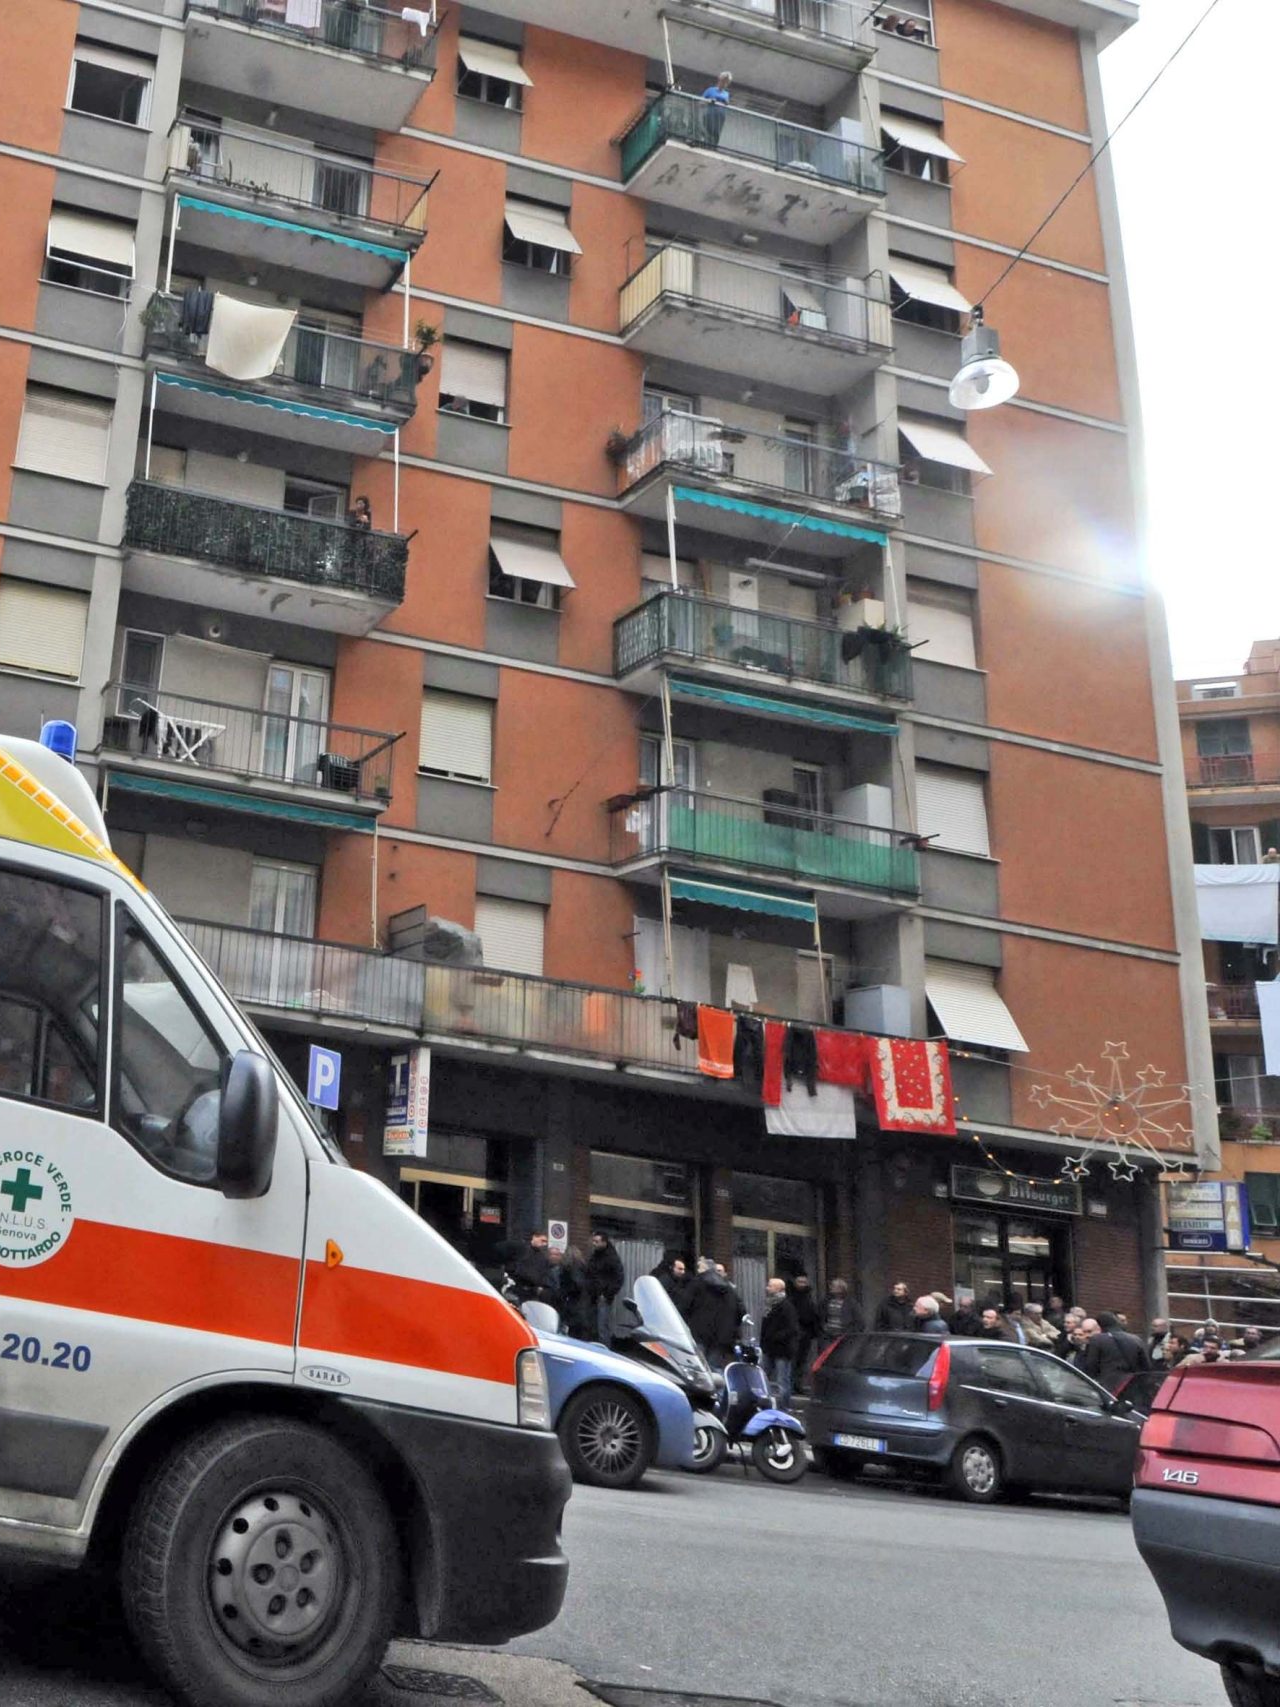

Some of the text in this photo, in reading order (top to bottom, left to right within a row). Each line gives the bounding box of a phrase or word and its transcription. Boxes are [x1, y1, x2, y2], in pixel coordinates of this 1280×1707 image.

[313, 1052, 336, 1100] P
[46, 1163, 72, 1212] VERDE
[1162, 1468, 1199, 1484] 146
